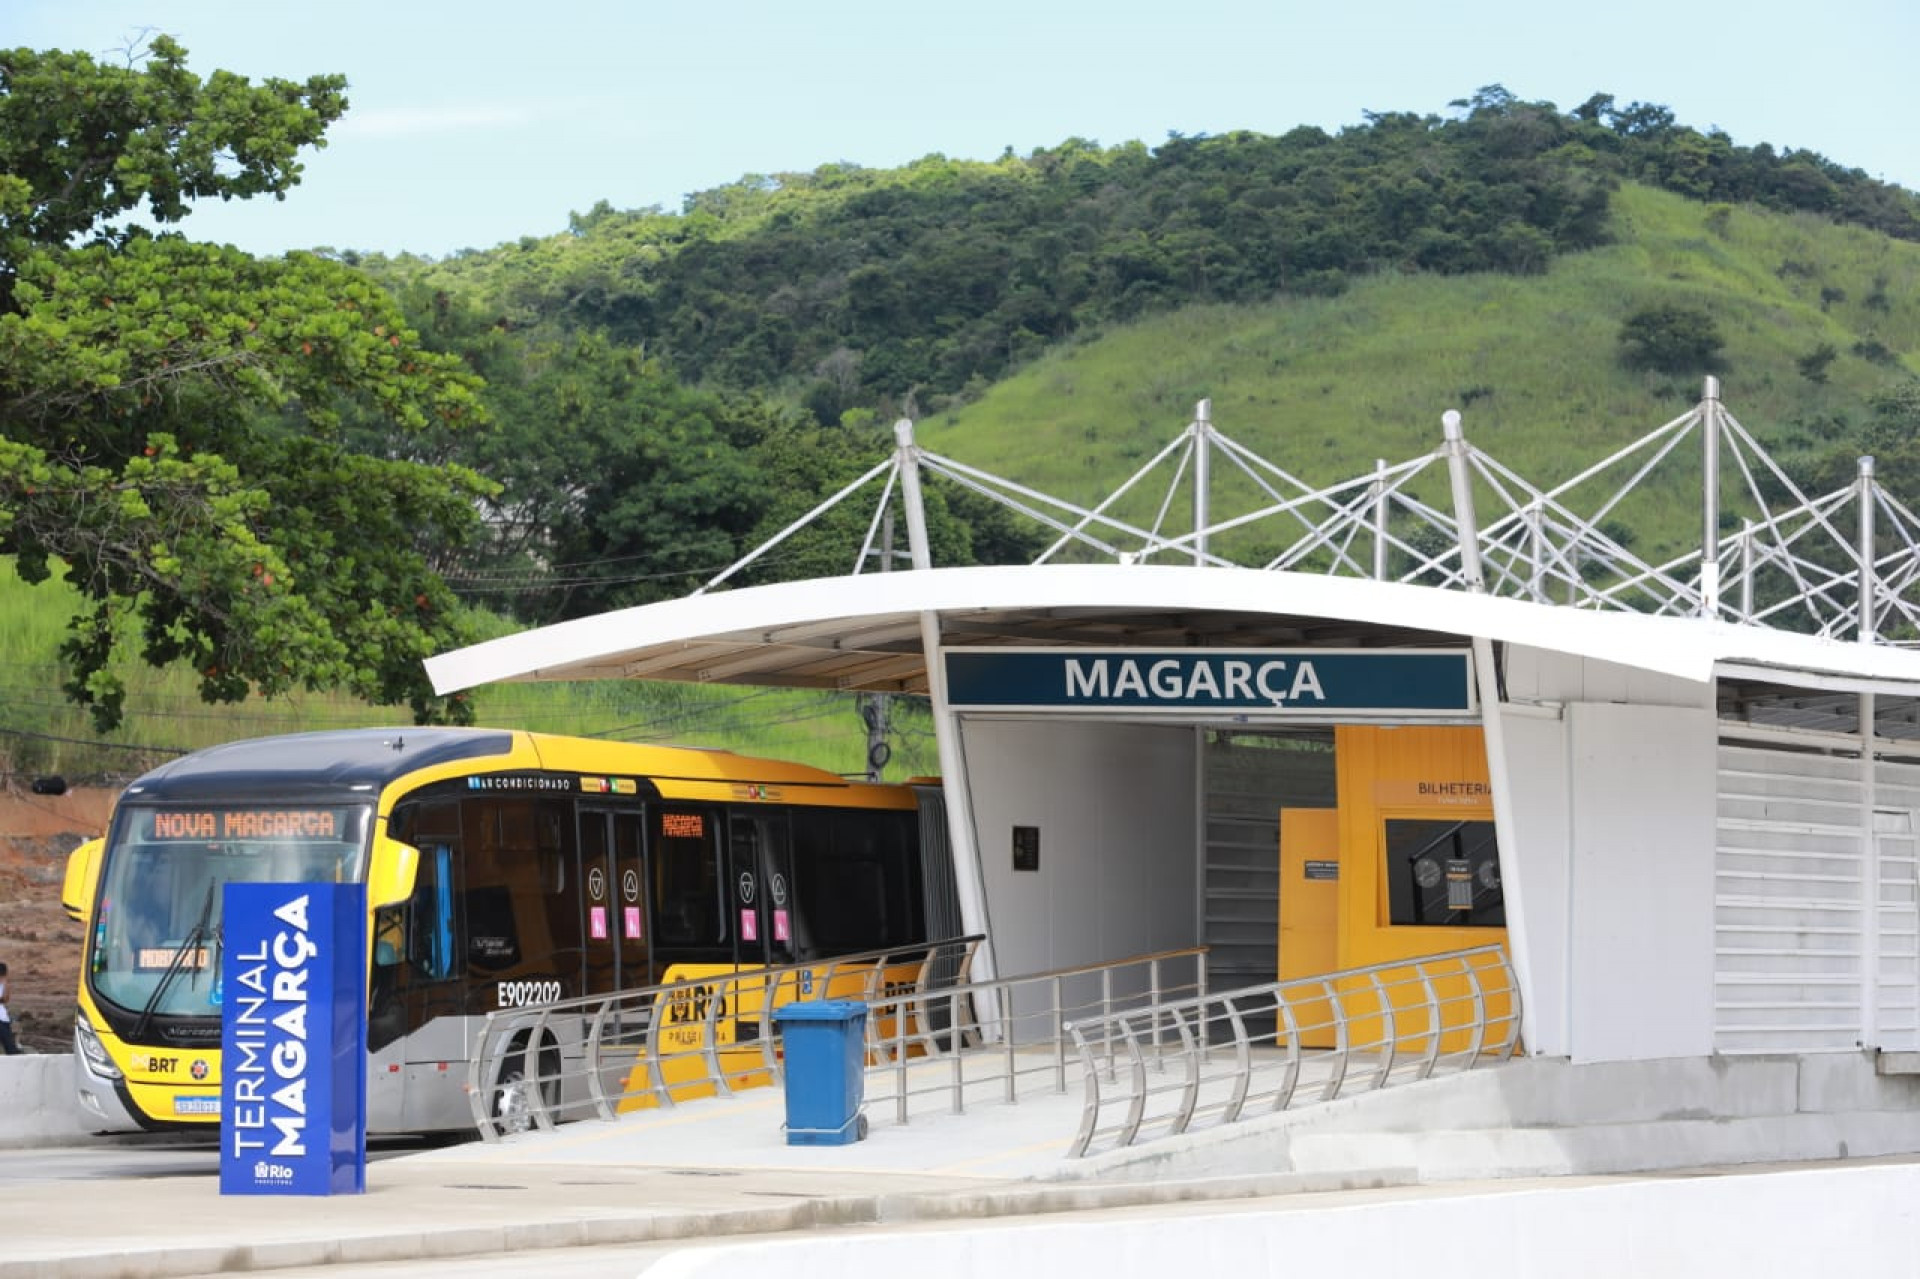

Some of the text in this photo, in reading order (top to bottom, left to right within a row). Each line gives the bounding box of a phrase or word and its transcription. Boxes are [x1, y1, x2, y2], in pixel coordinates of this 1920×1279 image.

[1065, 659, 1326, 708] MAGARÇA
[495, 777, 570, 790] CONDICIONADO
[155, 813, 217, 838] NOVA
[497, 981, 561, 1007] E902202
[270, 894, 317, 1156] MAGARÇA
[234, 939, 267, 1158] TERMINAL
[149, 1057, 179, 1073] BRT
[269, 1164, 293, 1178] Rio
